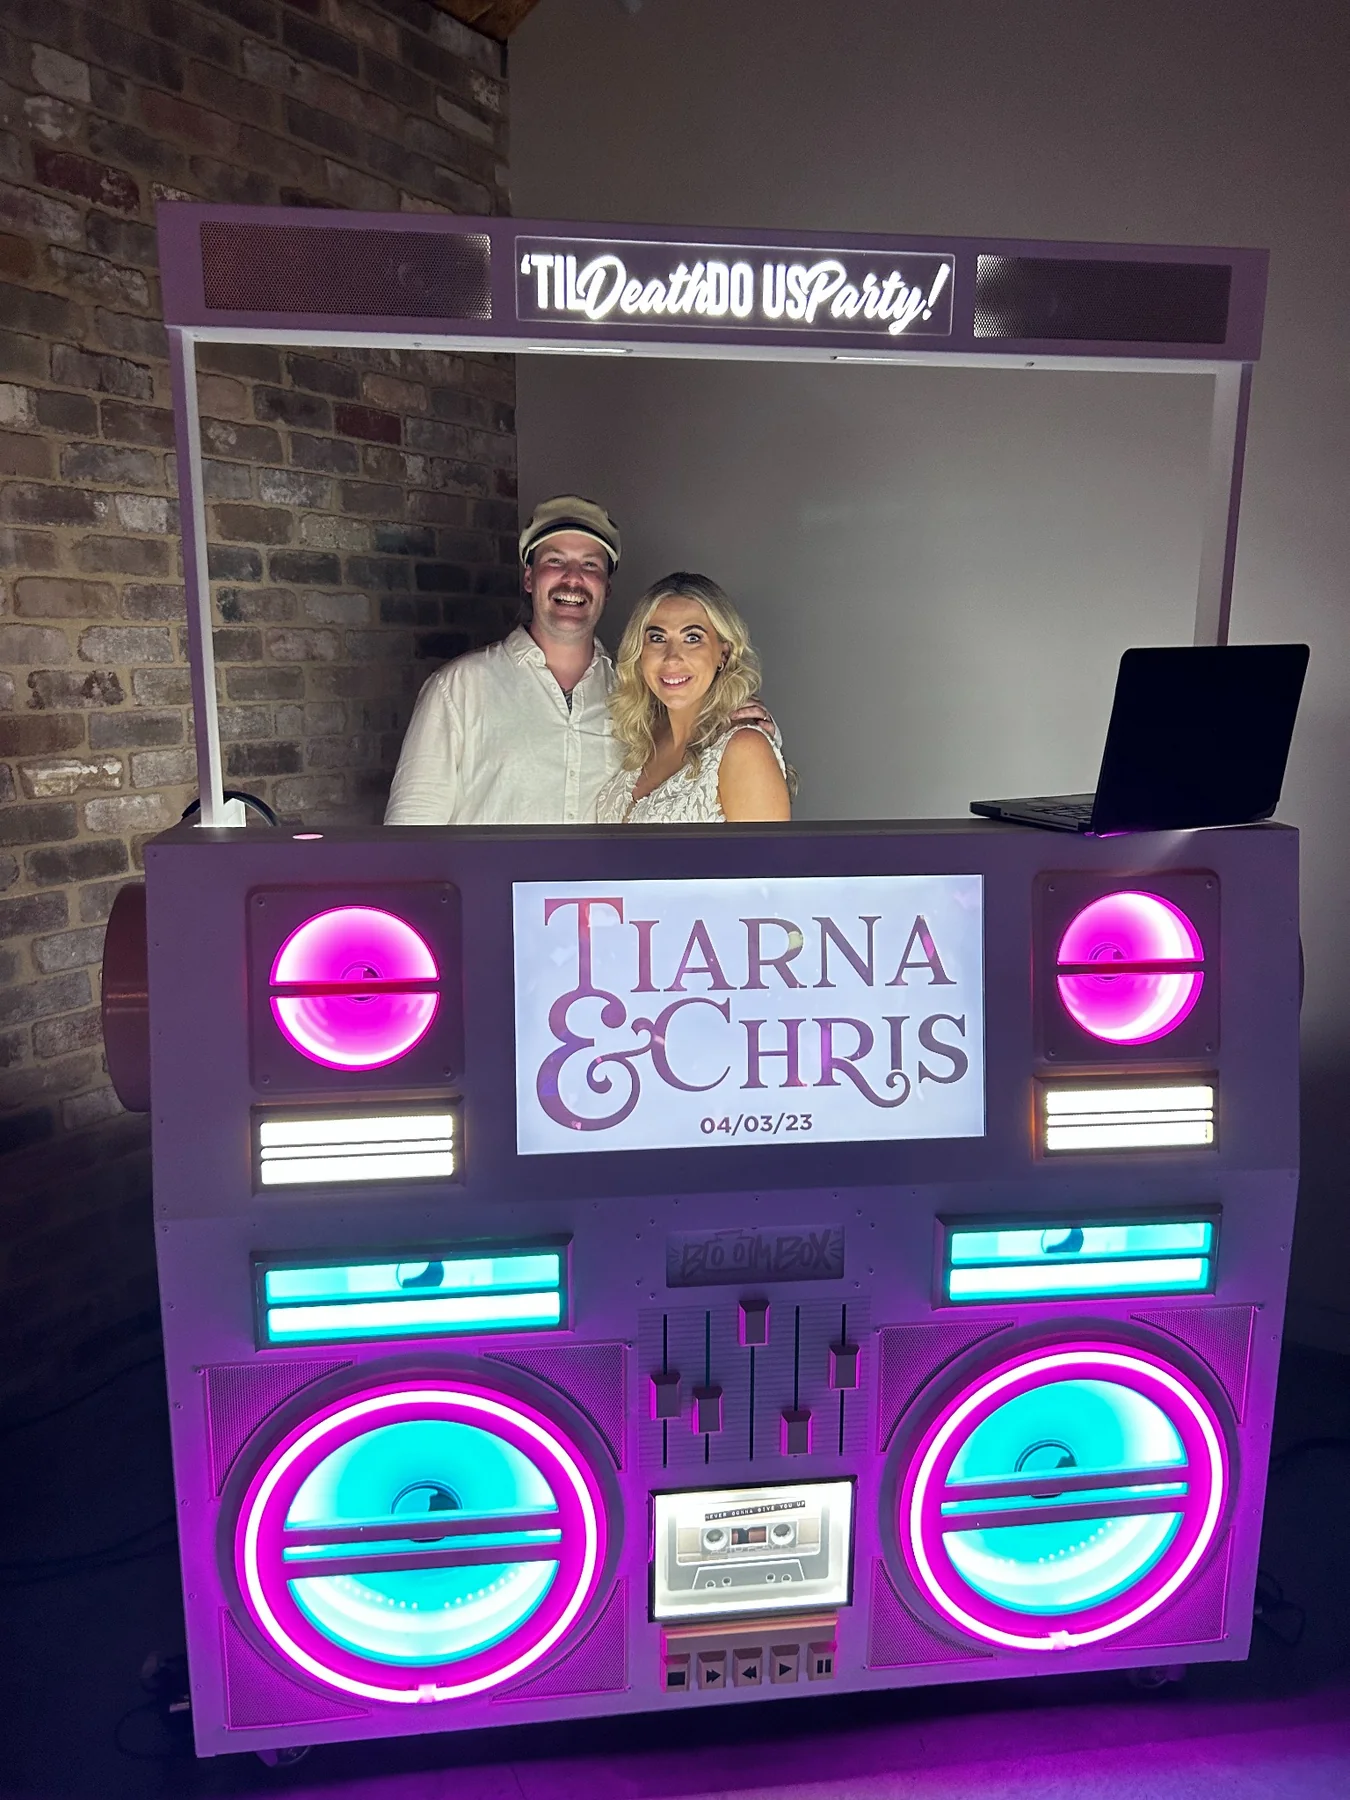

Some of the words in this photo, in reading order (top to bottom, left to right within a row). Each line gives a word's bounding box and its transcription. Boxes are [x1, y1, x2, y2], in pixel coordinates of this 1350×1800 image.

[576, 255, 708, 320] Death
[707, 261, 754, 318] DO
[762, 263, 803, 319] US
[800, 258, 951, 335] Party!
[544, 896, 957, 993] TIARNA
[650, 996, 969, 1108] CHRIS
[700, 1113, 813, 1137] 04/03/23
